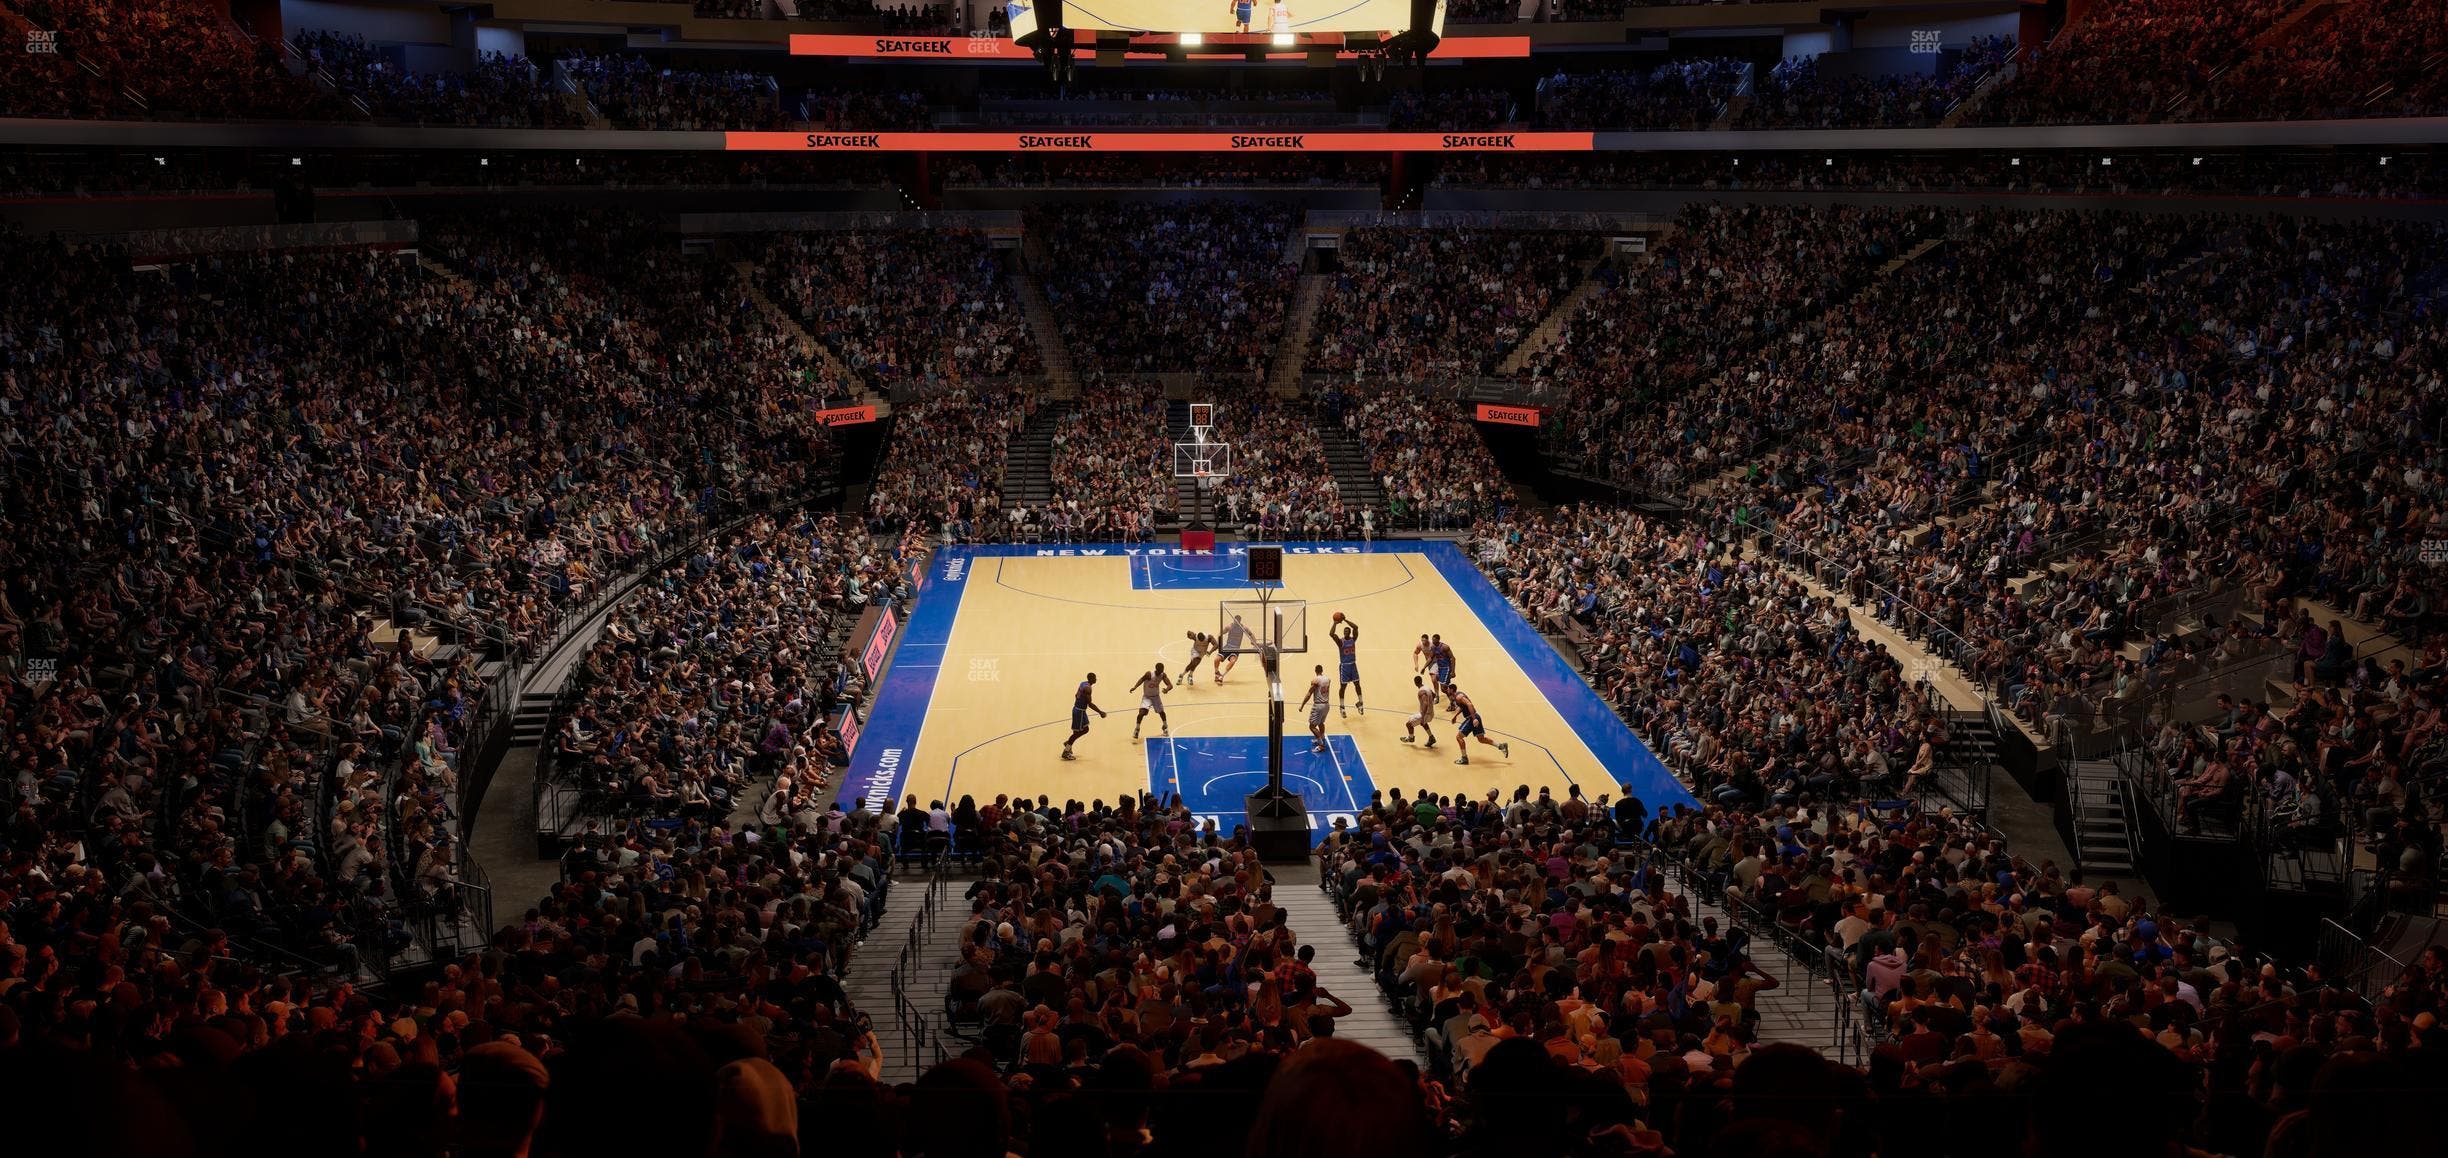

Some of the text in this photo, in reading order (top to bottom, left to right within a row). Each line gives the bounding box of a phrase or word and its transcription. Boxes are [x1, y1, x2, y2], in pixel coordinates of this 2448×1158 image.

[876, 39, 952, 54] SEATGEEK
[807, 134, 880, 148] SEATGEEK
[1019, 135, 1092, 149] SEATGEEK
[1231, 135, 1304, 149] SEATGEEK
[1443, 134, 1515, 149] SEATGEEK
[825, 410, 865, 424] SEATGEEK
[1488, 409, 1529, 423] SEATGEEK
